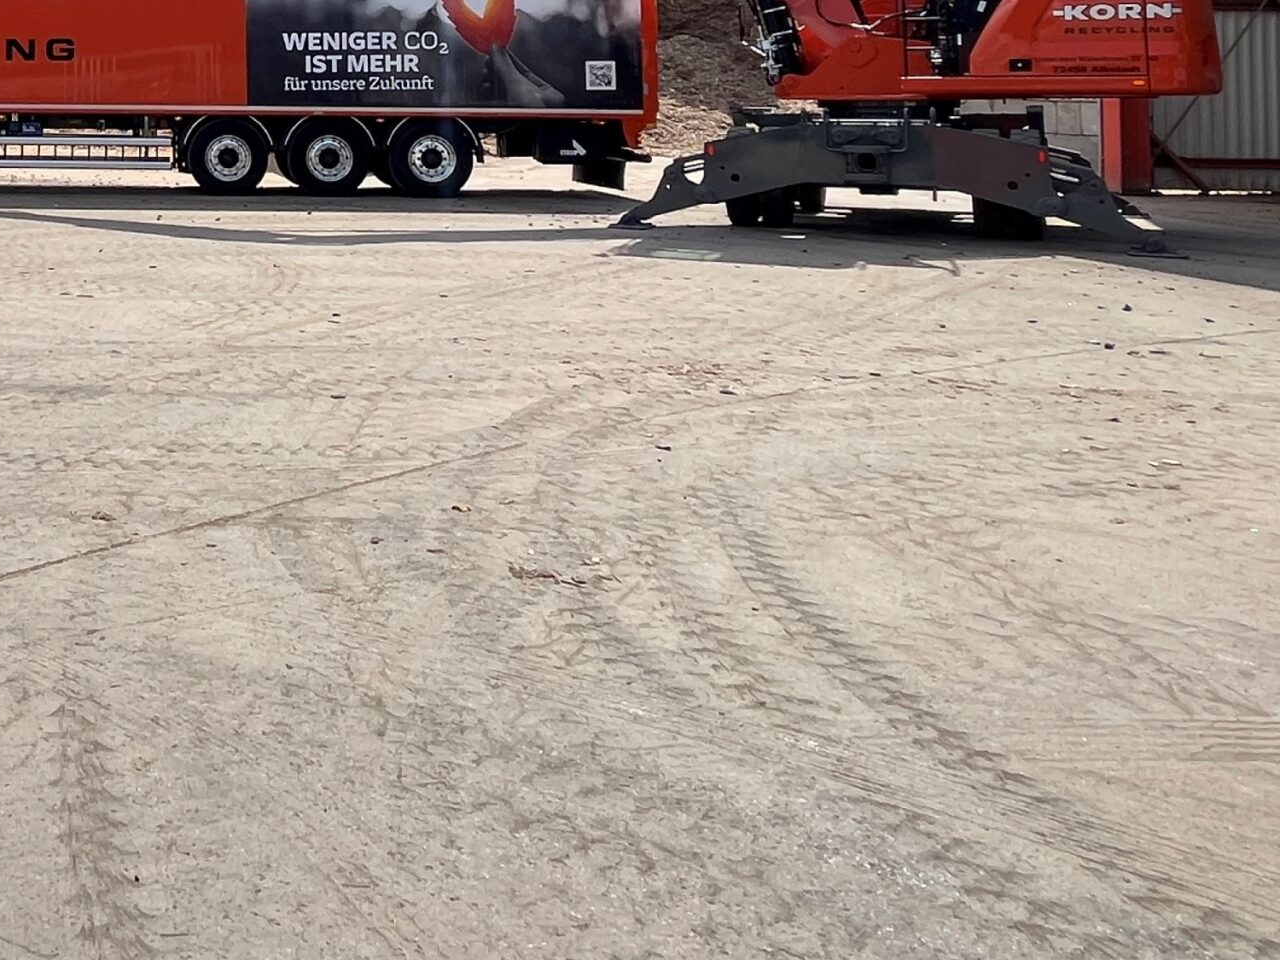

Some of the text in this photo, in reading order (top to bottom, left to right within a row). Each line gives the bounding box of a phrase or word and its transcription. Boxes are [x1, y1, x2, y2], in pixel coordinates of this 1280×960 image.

[1064, 3, 1172, 20] KORN
[1064, 26, 1175, 34] RECYCLING
[282, 32, 398, 51] WENIGER
[305, 54, 420, 73] IST MEHR
[284, 75, 435, 91] für unsere Zukunft
